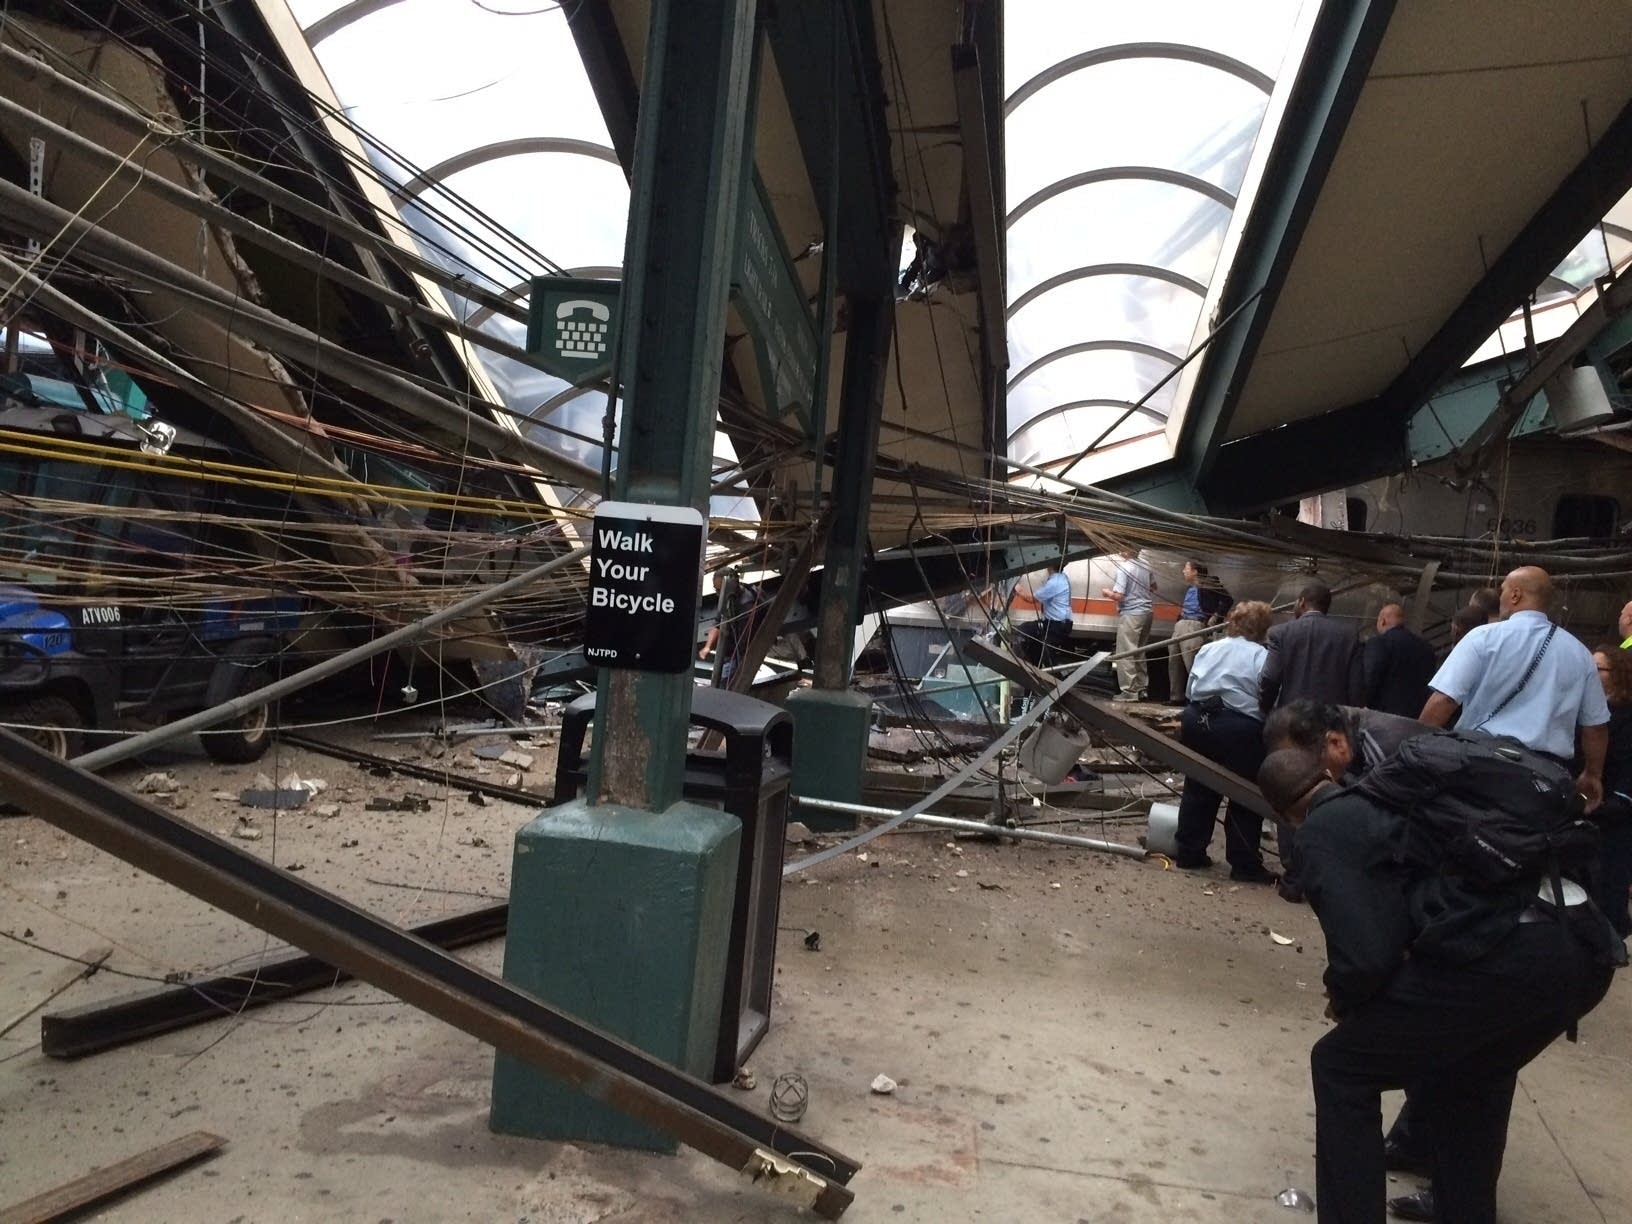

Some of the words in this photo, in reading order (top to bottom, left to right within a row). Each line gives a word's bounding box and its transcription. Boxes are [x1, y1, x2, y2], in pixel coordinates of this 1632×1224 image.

[599, 529, 654, 553] Walk
[597, 558, 650, 581] Your
[592, 587, 675, 615] Bicycle
[82, 606, 121, 625] ATV006
[587, 648, 618, 658] NJTPD
